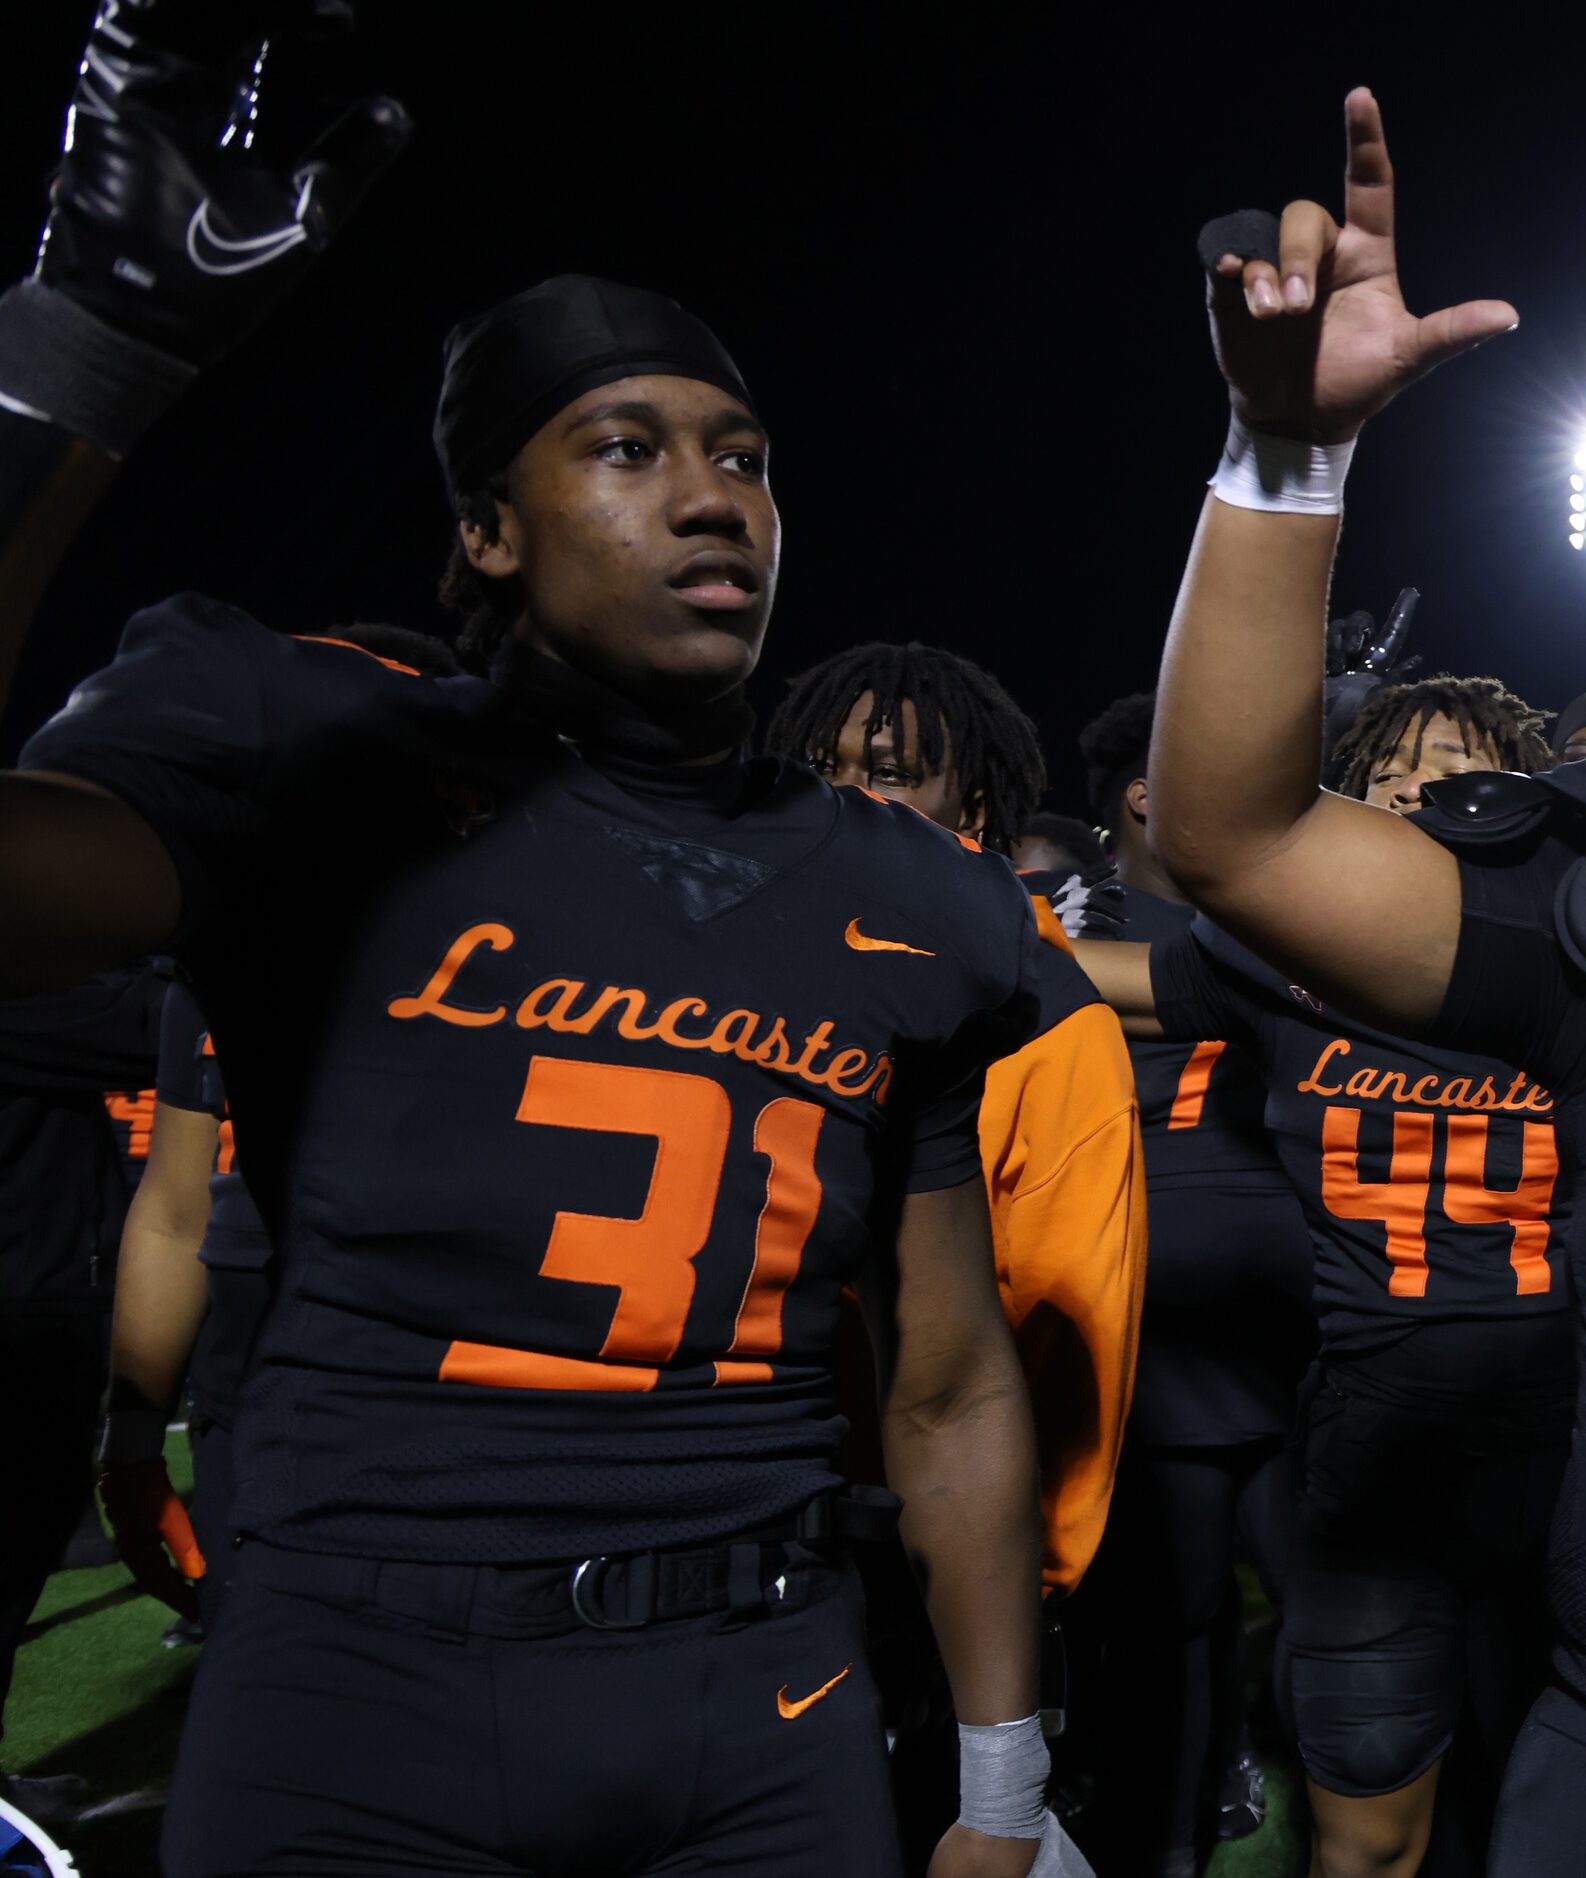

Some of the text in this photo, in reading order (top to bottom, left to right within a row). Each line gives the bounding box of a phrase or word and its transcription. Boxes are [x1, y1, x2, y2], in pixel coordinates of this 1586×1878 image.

[387, 922, 897, 1105] Lancaster
[438, 1055, 827, 1393] 31
[1320, 1104, 1561, 1298] 44
